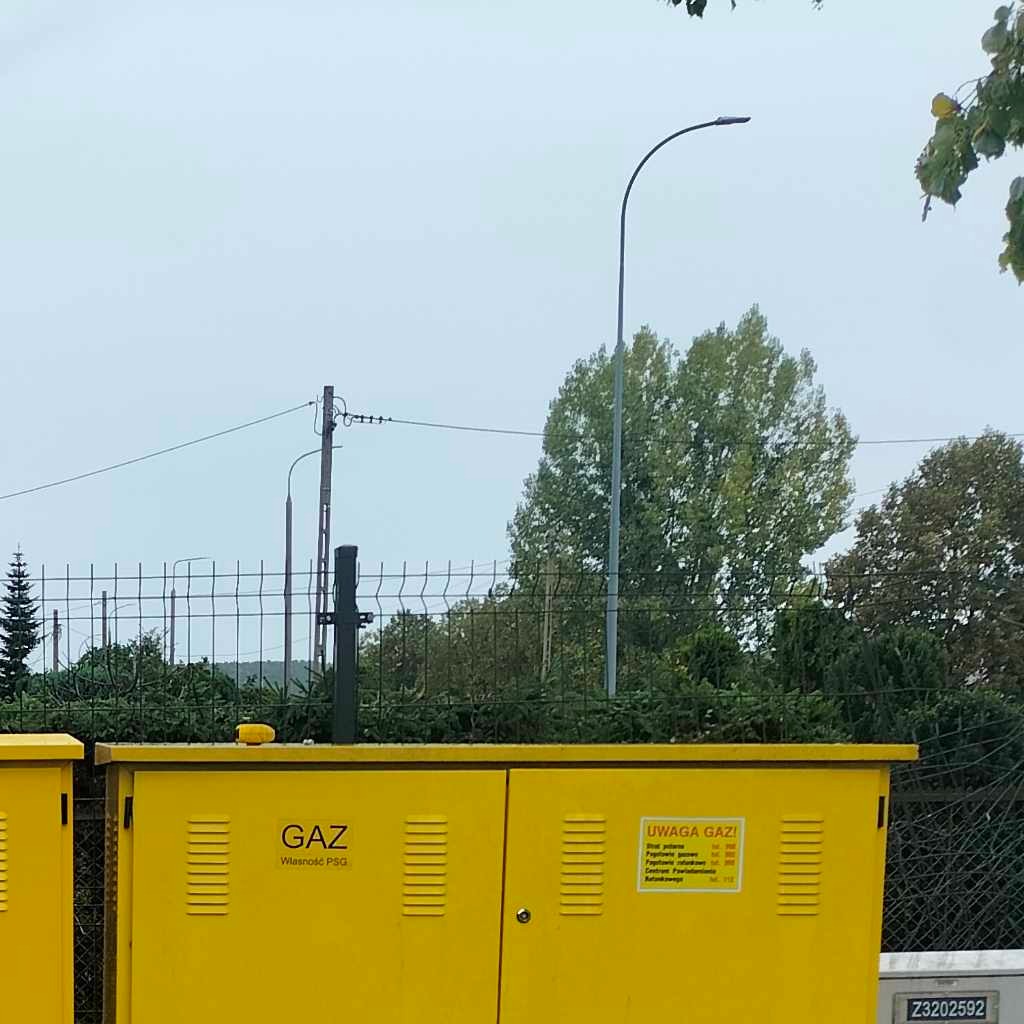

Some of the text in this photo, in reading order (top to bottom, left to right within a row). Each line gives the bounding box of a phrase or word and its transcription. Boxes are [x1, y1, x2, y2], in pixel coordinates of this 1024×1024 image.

[281, 824, 348, 849] GAZ
[647, 825, 737, 838] UWAGA GAZ!
[326, 857, 348, 866] PSG
[912, 1000, 985, 1017] Z3202592
